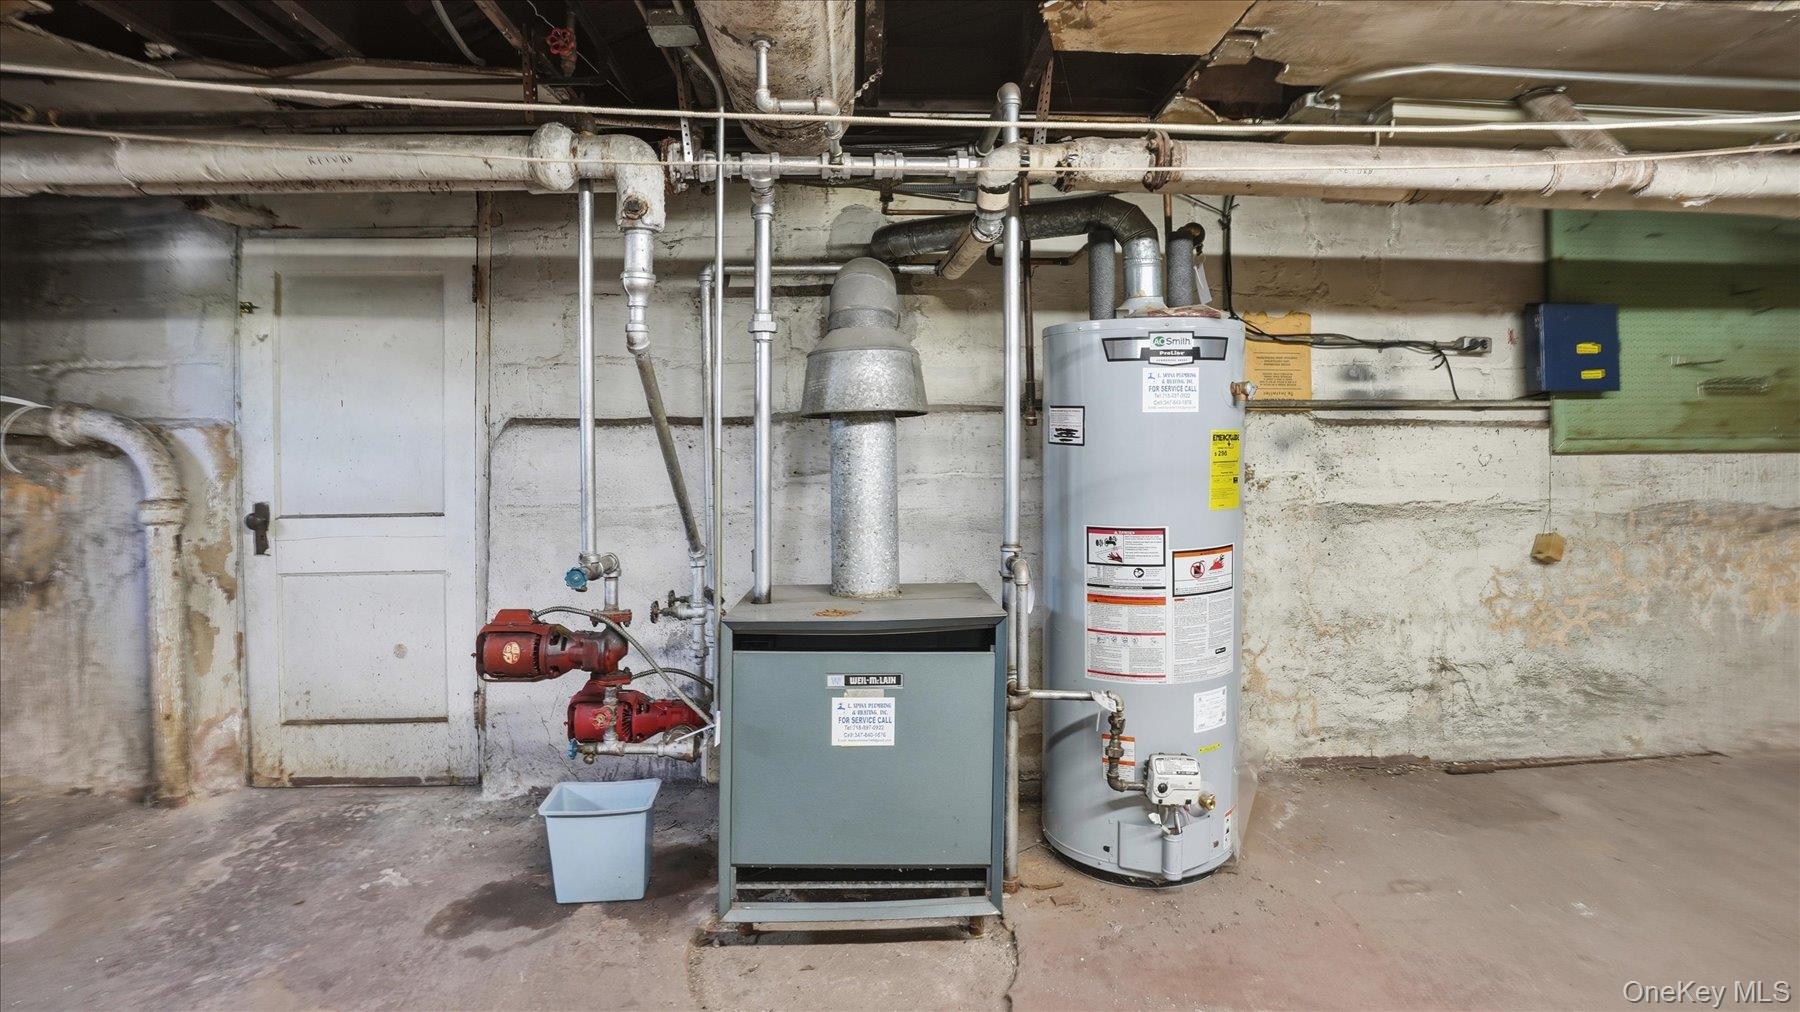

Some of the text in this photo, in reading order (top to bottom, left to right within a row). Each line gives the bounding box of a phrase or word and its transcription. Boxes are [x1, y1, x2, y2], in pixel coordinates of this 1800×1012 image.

[1165, 337, 1191, 345] Smith
[838, 716, 893, 724] FOR SERVICE CALL
